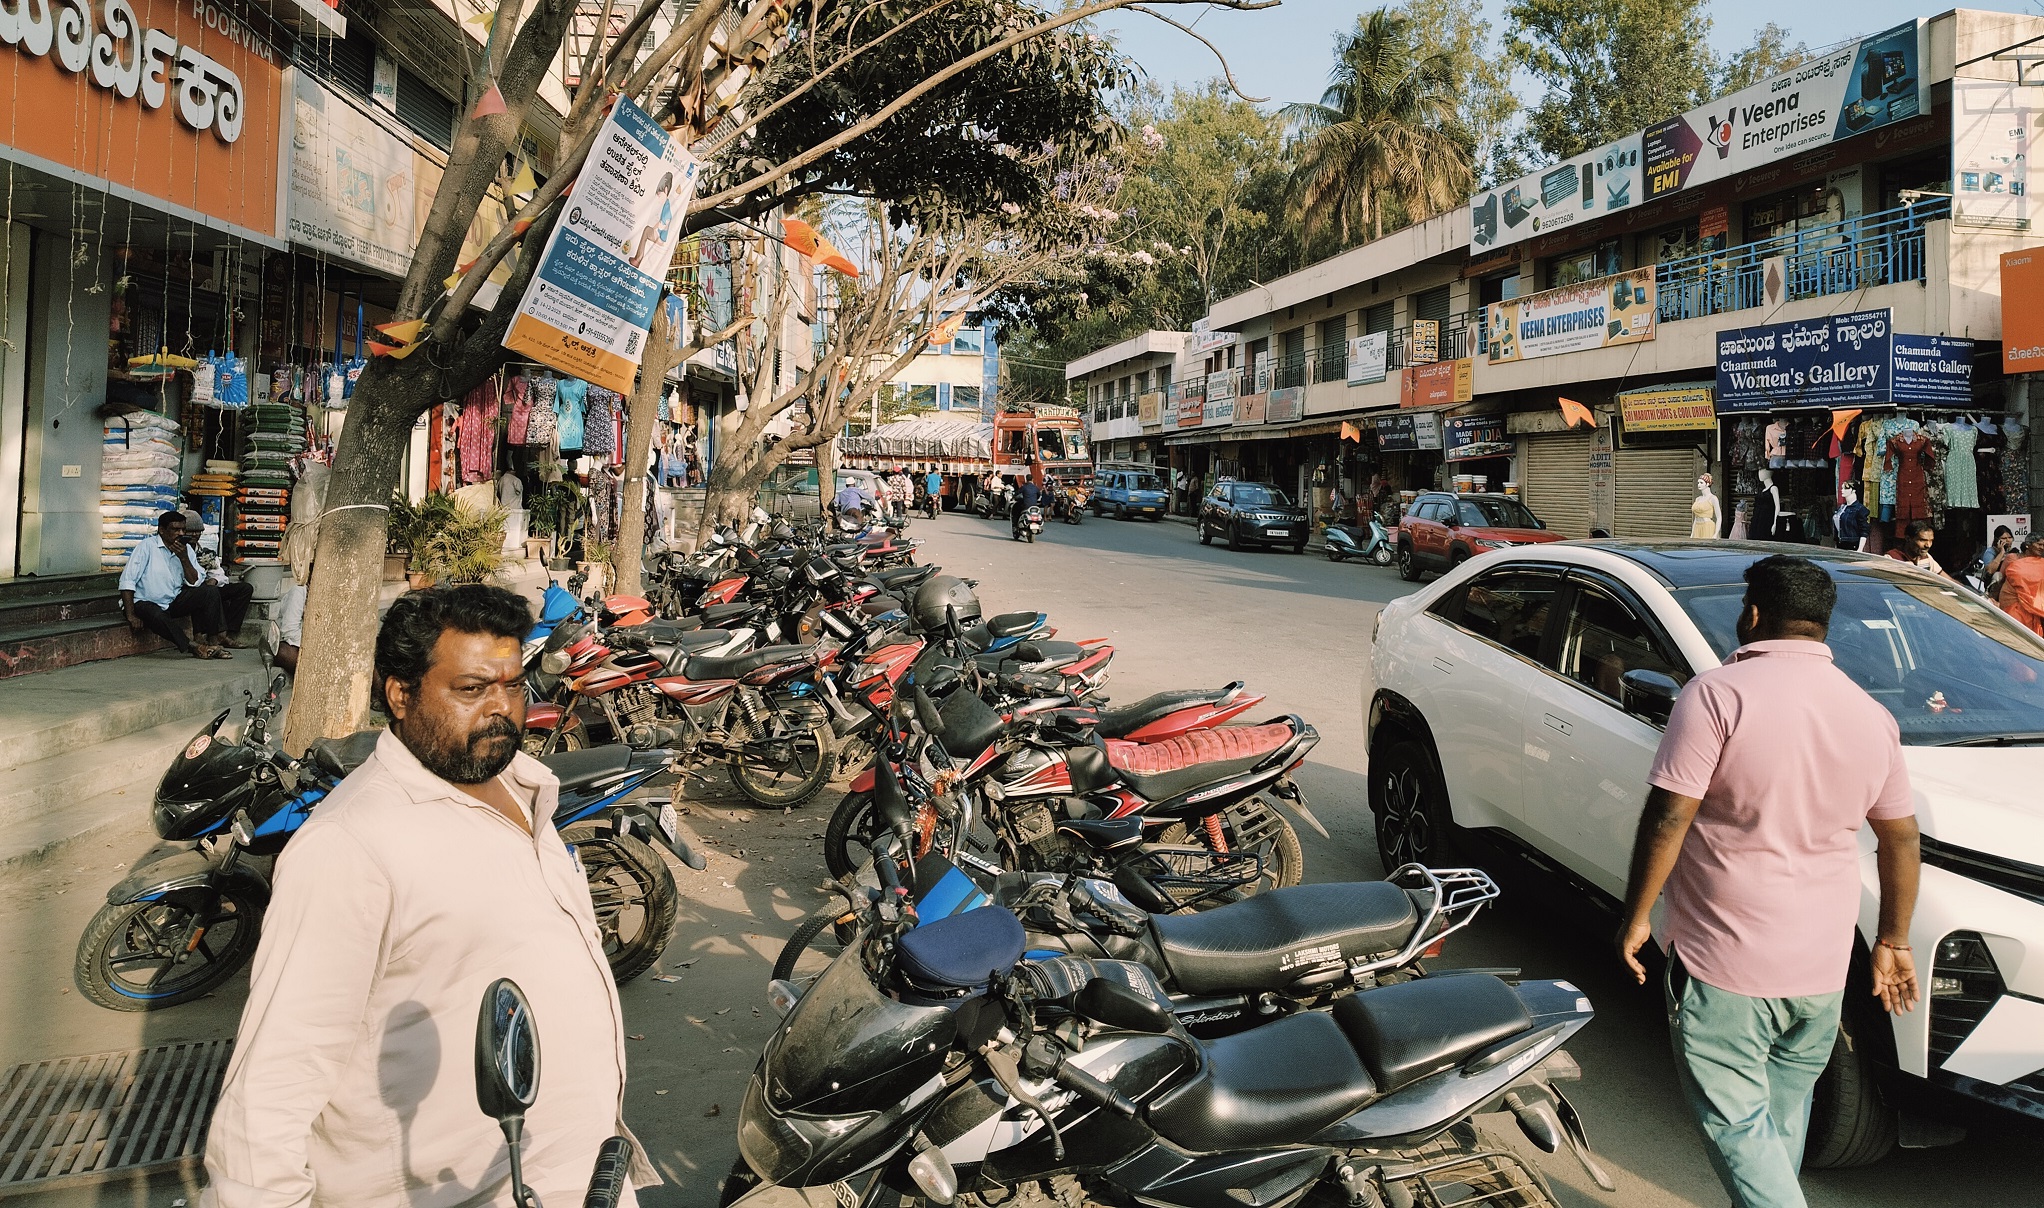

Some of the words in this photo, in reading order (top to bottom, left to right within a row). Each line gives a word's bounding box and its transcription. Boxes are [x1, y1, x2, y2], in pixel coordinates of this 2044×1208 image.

[192, 0, 274, 64] POORVIKA
[1742, 92, 1800, 127] Veena
[1742, 110, 1826, 150] Enterprises
[2008, 128, 2024, 137] EMI
[1647, 139, 1662, 148] Laptops
[1647, 145, 1667, 155] Computers
[1774, 145, 1784, 154] One
[605, 144, 627, 166] ಉಚಿತ
[1647, 154, 1662, 163] Printers
[598, 157, 629, 186] ತಪಾಸಣಾ
[1647, 157, 1681, 176] Available
[1682, 153, 1694, 164] for
[1653, 169, 1680, 194] EMI
[1541, 213, 1574, 230] 9620672608
[563, 231, 579, 246] ಇದು
[356, 239, 372, 256] HEERA
[2006, 255, 2032, 267] Xiaomi
[1520, 314, 1545, 341] VEENA
[1546, 306, 1605, 336] ENTERPRISES
[1631, 313, 1651, 328] EMI
[1835, 316, 1850, 324] Mob:
[1850, 311, 1887, 322] 7022554711
[1720, 331, 1775, 356] ಚಾಮುಂಡ
[1837, 320, 1886, 350] ಗ್ಯಾಲರಿ
[1895, 345, 1942, 357] Chamunda
[1721, 356, 1777, 372] Chamunda
[1894, 358, 1937, 373] Women's
[1938, 360, 1973, 379] Gallery
[1730, 368, 1804, 390] Women's
[1808, 362, 1880, 387] Gallery
[1624, 410, 1633, 422] SRI
[1633, 409, 1656, 421] MARUTHI
[1656, 407, 1673, 420] CHATS
[1673, 410, 1677, 418] &
[1677, 406, 1692, 419] COOL
[1692, 405, 1713, 418] DRINKS
[1456, 430, 1473, 438] MADE
[1473, 428, 1503, 442] INDIA
[1294, 947, 1318, 958] LAKSHMI
[1318, 943, 1340, 953] MOTORS
[1507, 1048, 1535, 1076] 150
